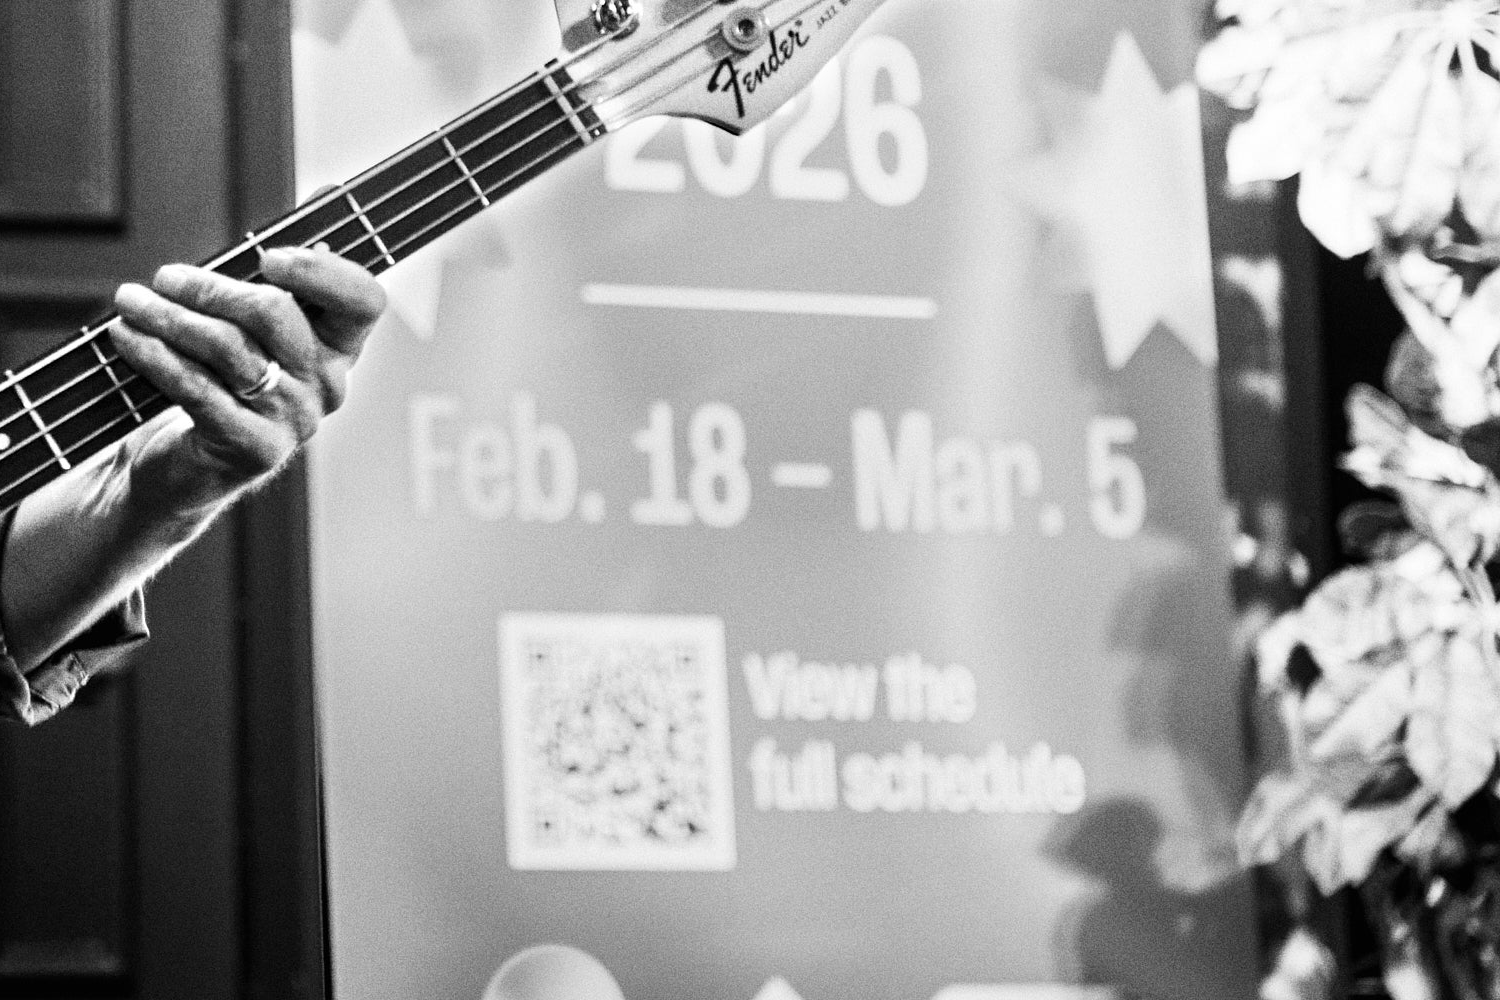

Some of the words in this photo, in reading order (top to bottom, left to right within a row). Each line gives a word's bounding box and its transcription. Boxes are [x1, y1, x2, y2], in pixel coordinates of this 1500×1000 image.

[707, 29, 810, 118] Fender
[408, 391, 606, 522] Feb.
[630, 401, 752, 528] 18
[850, 408, 1066, 538] Mar.
[1086, 415, 1146, 539] 5
[882, 652, 977, 724] the
[748, 736, 838, 812] full
[841, 738, 1086, 814] schedule
